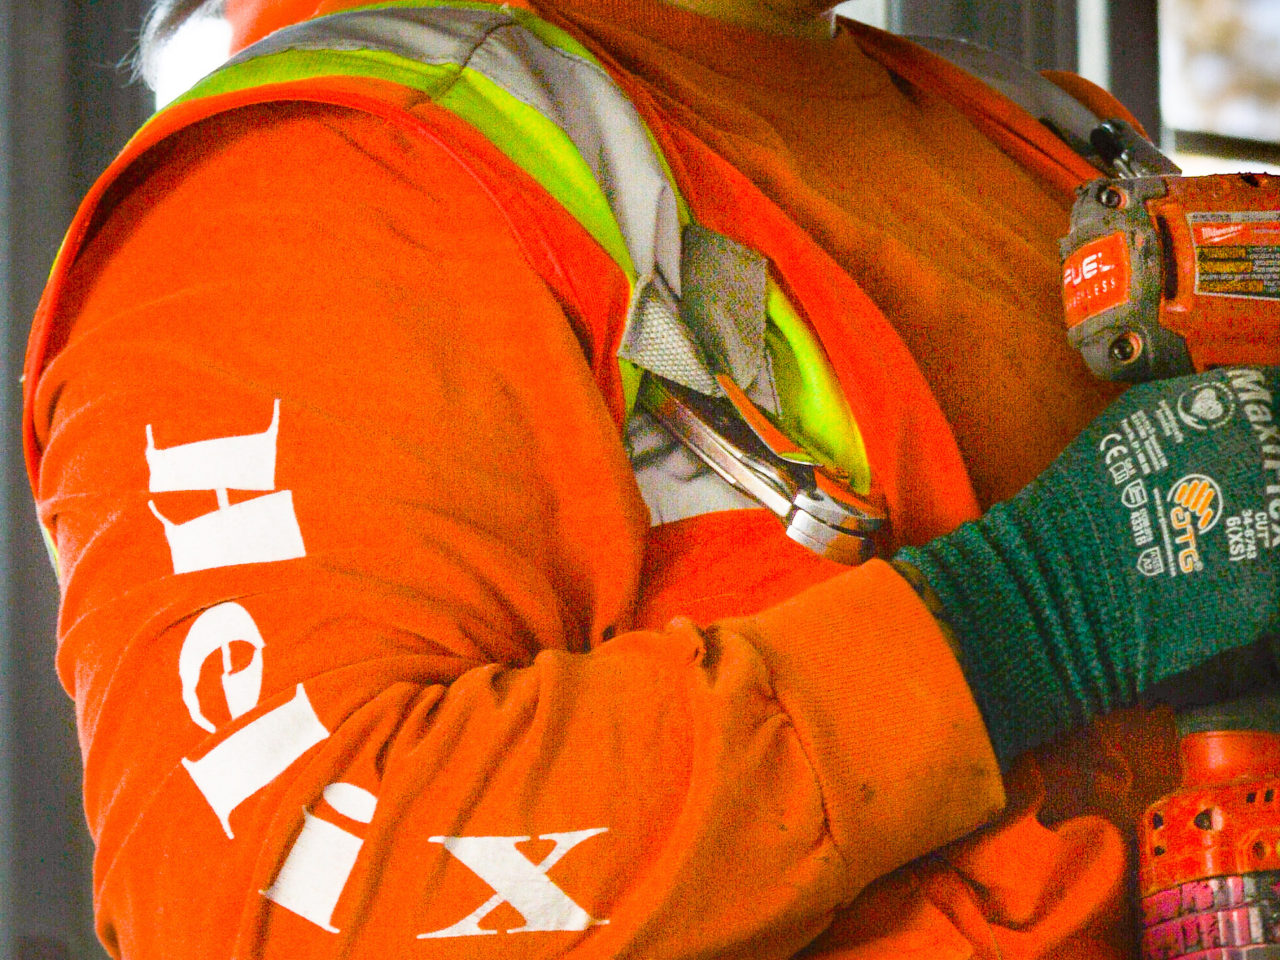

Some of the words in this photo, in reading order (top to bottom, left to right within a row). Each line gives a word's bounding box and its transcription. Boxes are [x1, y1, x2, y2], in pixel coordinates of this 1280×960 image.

[1063, 251, 1115, 286] FUEL
[1226, 516, 1245, 561] 6(XS)
[145, 399, 610, 939] Helix
